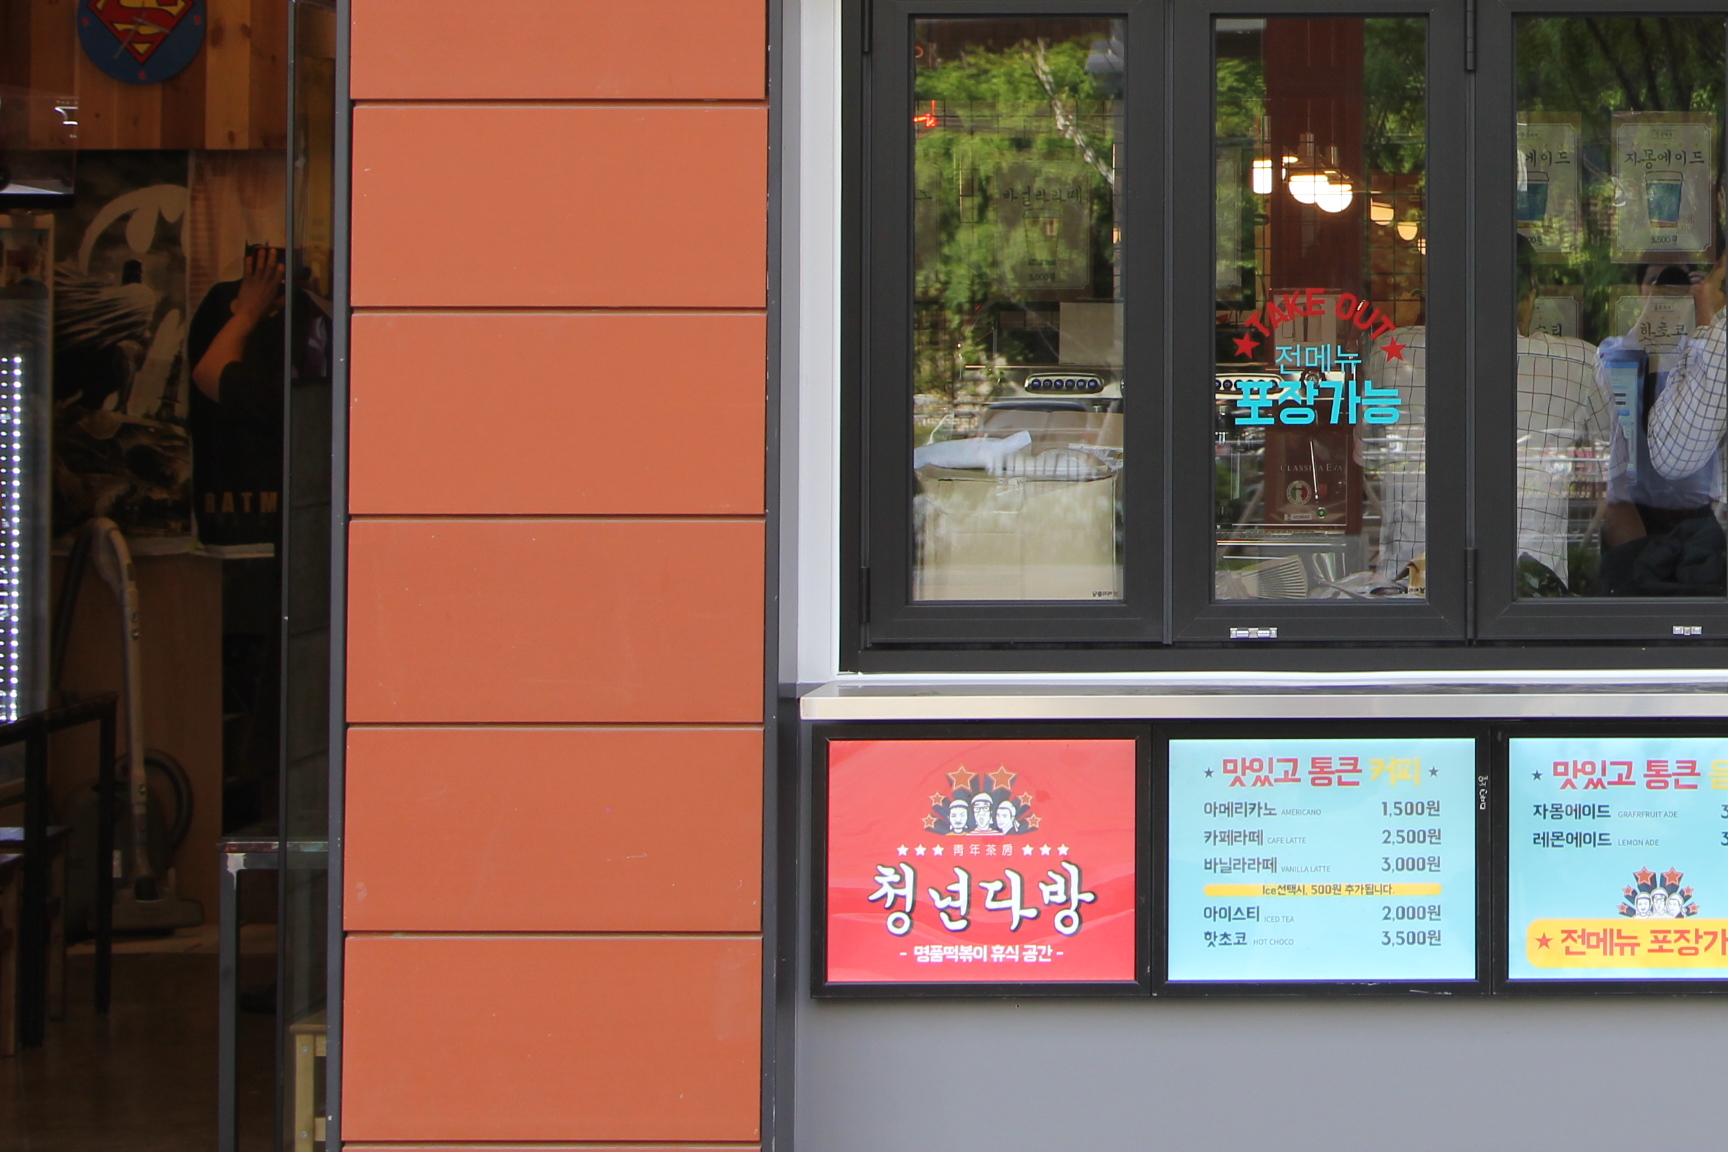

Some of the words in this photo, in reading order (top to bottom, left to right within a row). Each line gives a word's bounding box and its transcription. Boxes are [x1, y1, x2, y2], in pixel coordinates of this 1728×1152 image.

[1623, 148, 1705, 170] 자몽에이드
[1244, 288, 1326, 337] TAKE
[1335, 292, 1397, 340] OUT
[1275, 343, 1362, 375] 전메뉴
[1234, 380, 1402, 426] 포장가능
[1222, 756, 1301, 787] 맛있고
[1308, 756, 1363, 787] 통큰
[1369, 756, 1421, 787] 커피
[1552, 759, 1636, 790] 맛있고
[1643, 759, 1701, 790] 통큰
[1203, 800, 1277, 818] 아메리카노
[1281, 808, 1322, 816] AMERICANO
[1381, 800, 1441, 818] 1,500원
[1532, 803, 1612, 820] 자몽에이드
[1203, 829, 1264, 846] 카페라떼
[1267, 836, 1285, 845] CAFE
[1285, 836, 1307, 845] LATTE
[1381, 828, 1442, 845] 2,500원
[1532, 831, 1612, 848] 레몬에이드
[1617, 839, 1644, 847] LEMON
[1645, 839, 1660, 847] ADE
[1203, 856, 1277, 874] 바닐라라떼
[1281, 865, 1309, 873] VANILLA
[1309, 865, 1331, 873] LATTE
[1381, 855, 1441, 873] 3,000원
[867, 860, 1099, 936] 청년다방
[1311, 884, 1342, 895] 500원
[1203, 905, 1260, 922] 아이스티
[1381, 905, 1442, 922] 2,000원
[1203, 931, 1248, 948] 핫초코
[1253, 938, 1267, 946] HOT
[1269, 938, 1294, 946] CHOCO
[1381, 930, 1442, 947] 3,500원
[1560, 928, 1641, 956] 전메뉴
[913, 945, 988, 963] 명품떡볶이
[990, 945, 1020, 963] 휴식
[1022, 945, 1053, 963] 공간
